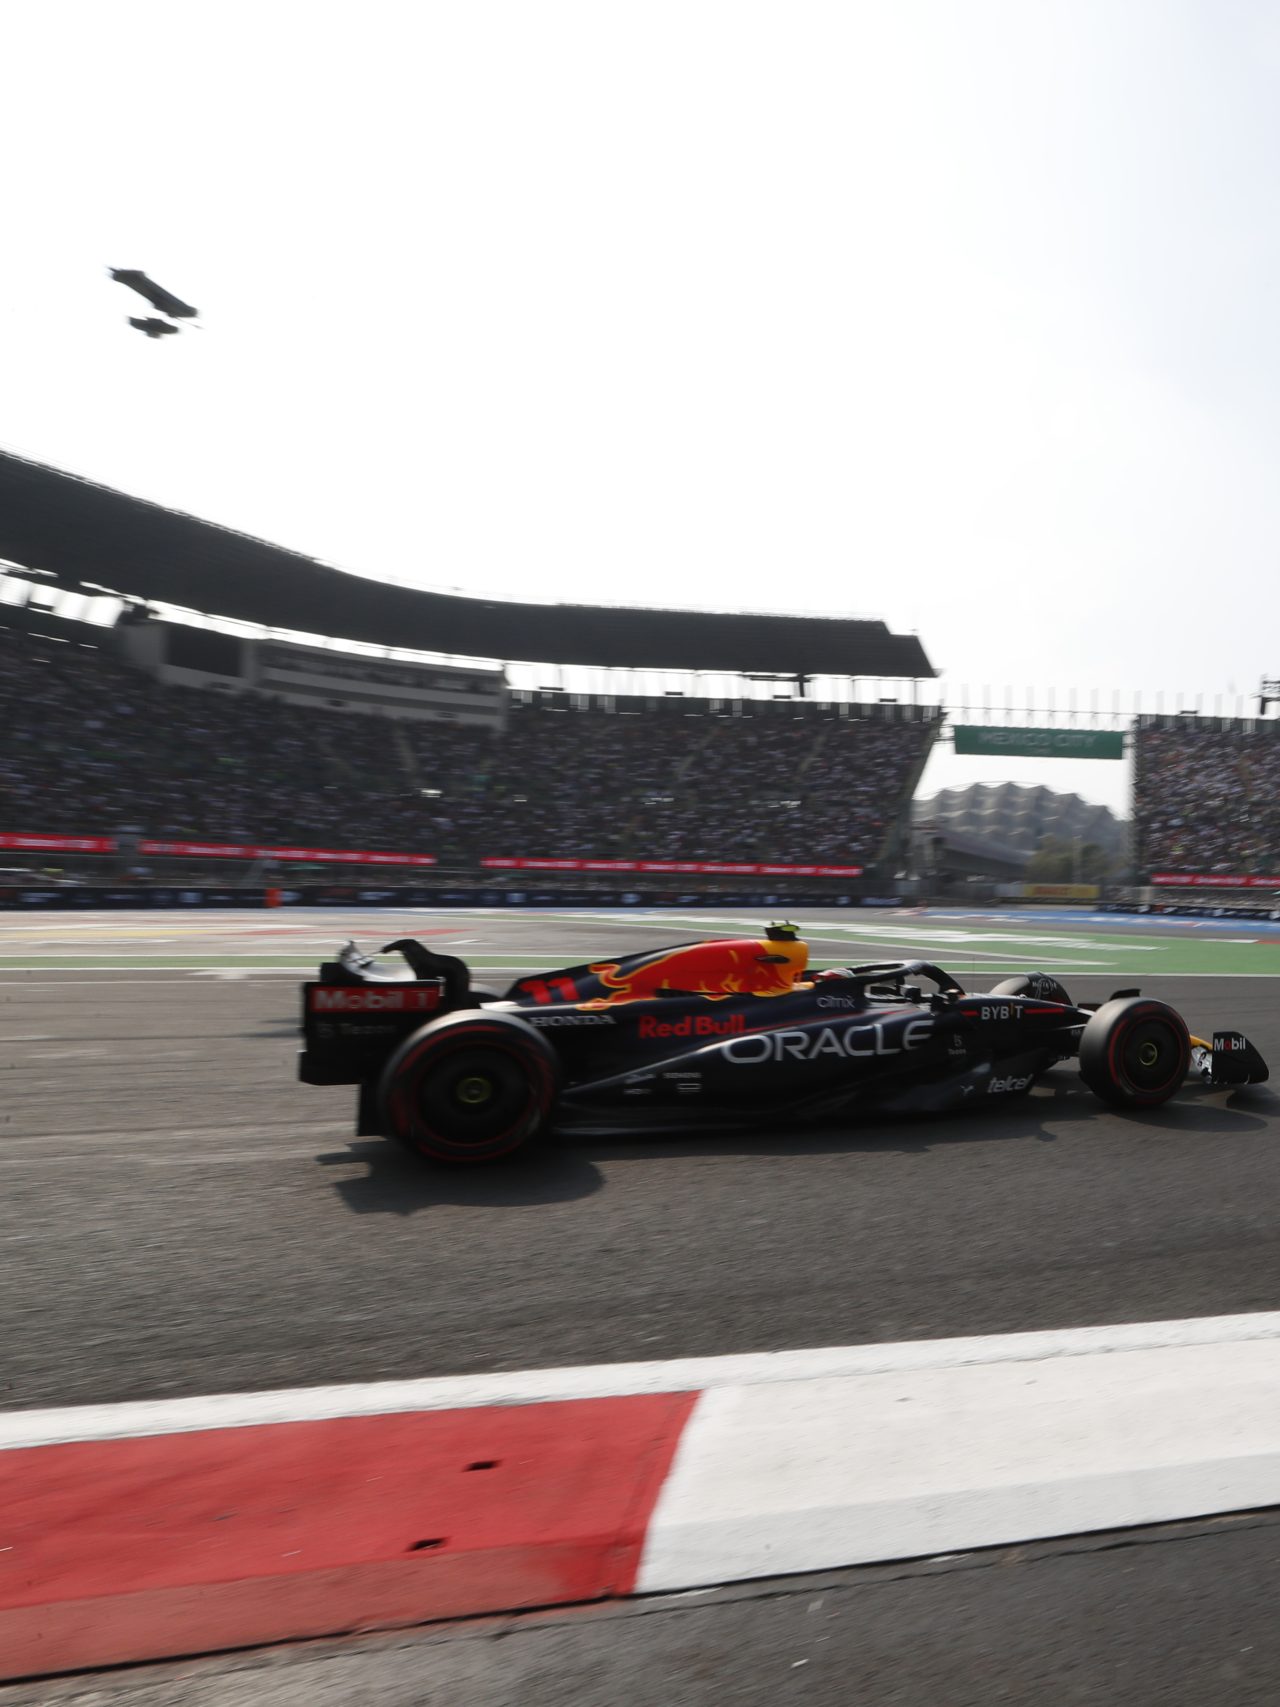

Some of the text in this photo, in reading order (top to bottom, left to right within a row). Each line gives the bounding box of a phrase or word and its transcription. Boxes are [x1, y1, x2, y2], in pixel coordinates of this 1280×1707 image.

[313, 989, 429, 1009] Mobil 1
[519, 977, 580, 1005] 11
[528, 1014, 618, 1027] HONDA
[639, 1013, 745, 1038] Red Bull
[721, 1020, 935, 1064] ORACLE
[1214, 1038, 1246, 1051] Mobil
[987, 1073, 1034, 1093] telcel
